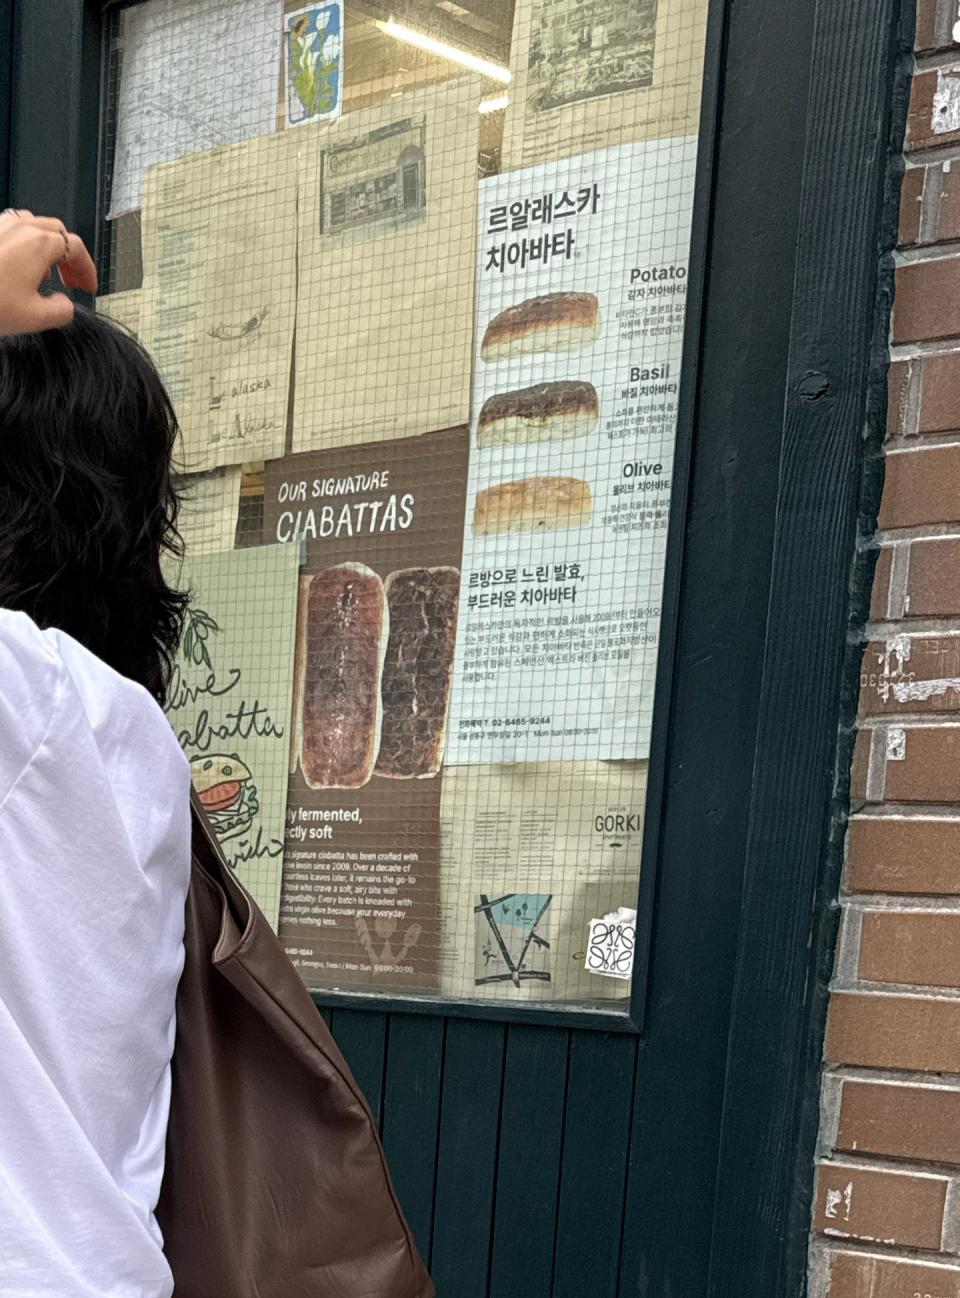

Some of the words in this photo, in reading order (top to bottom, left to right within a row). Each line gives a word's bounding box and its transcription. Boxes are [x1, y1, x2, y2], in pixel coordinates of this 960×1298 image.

[487, 183, 601, 235] 르알래스카
[485, 228, 576, 274] 치아바타
[630, 265, 687, 284] Potato
[627, 288, 645, 301] 감자
[647, 284, 687, 299] 치아바타
[630, 363, 670, 382] Basil
[621, 387, 638, 399] 바질
[640, 384, 677, 397] 치아바타
[623, 461, 663, 478] Olive
[278, 481, 307, 503] OUR
[311, 470, 390, 498] SIGNATURE
[276, 493, 415, 544] CIABATTAS
[468, 568, 518, 588] 르방으로
[521, 565, 550, 583] 느린
[553, 563, 584, 582] 발효,
[467, 590, 517, 611] 부드러운
[519, 585, 578, 606] 치아바타
[164, 664, 241, 714] live
[178, 700, 284, 751] abatta
[288, 807, 297, 824] ly
[298, 807, 363, 825] fermented,
[595, 814, 640, 832] GORKI
[285, 825, 308, 842] ectly
[309, 825, 334, 840] soft
